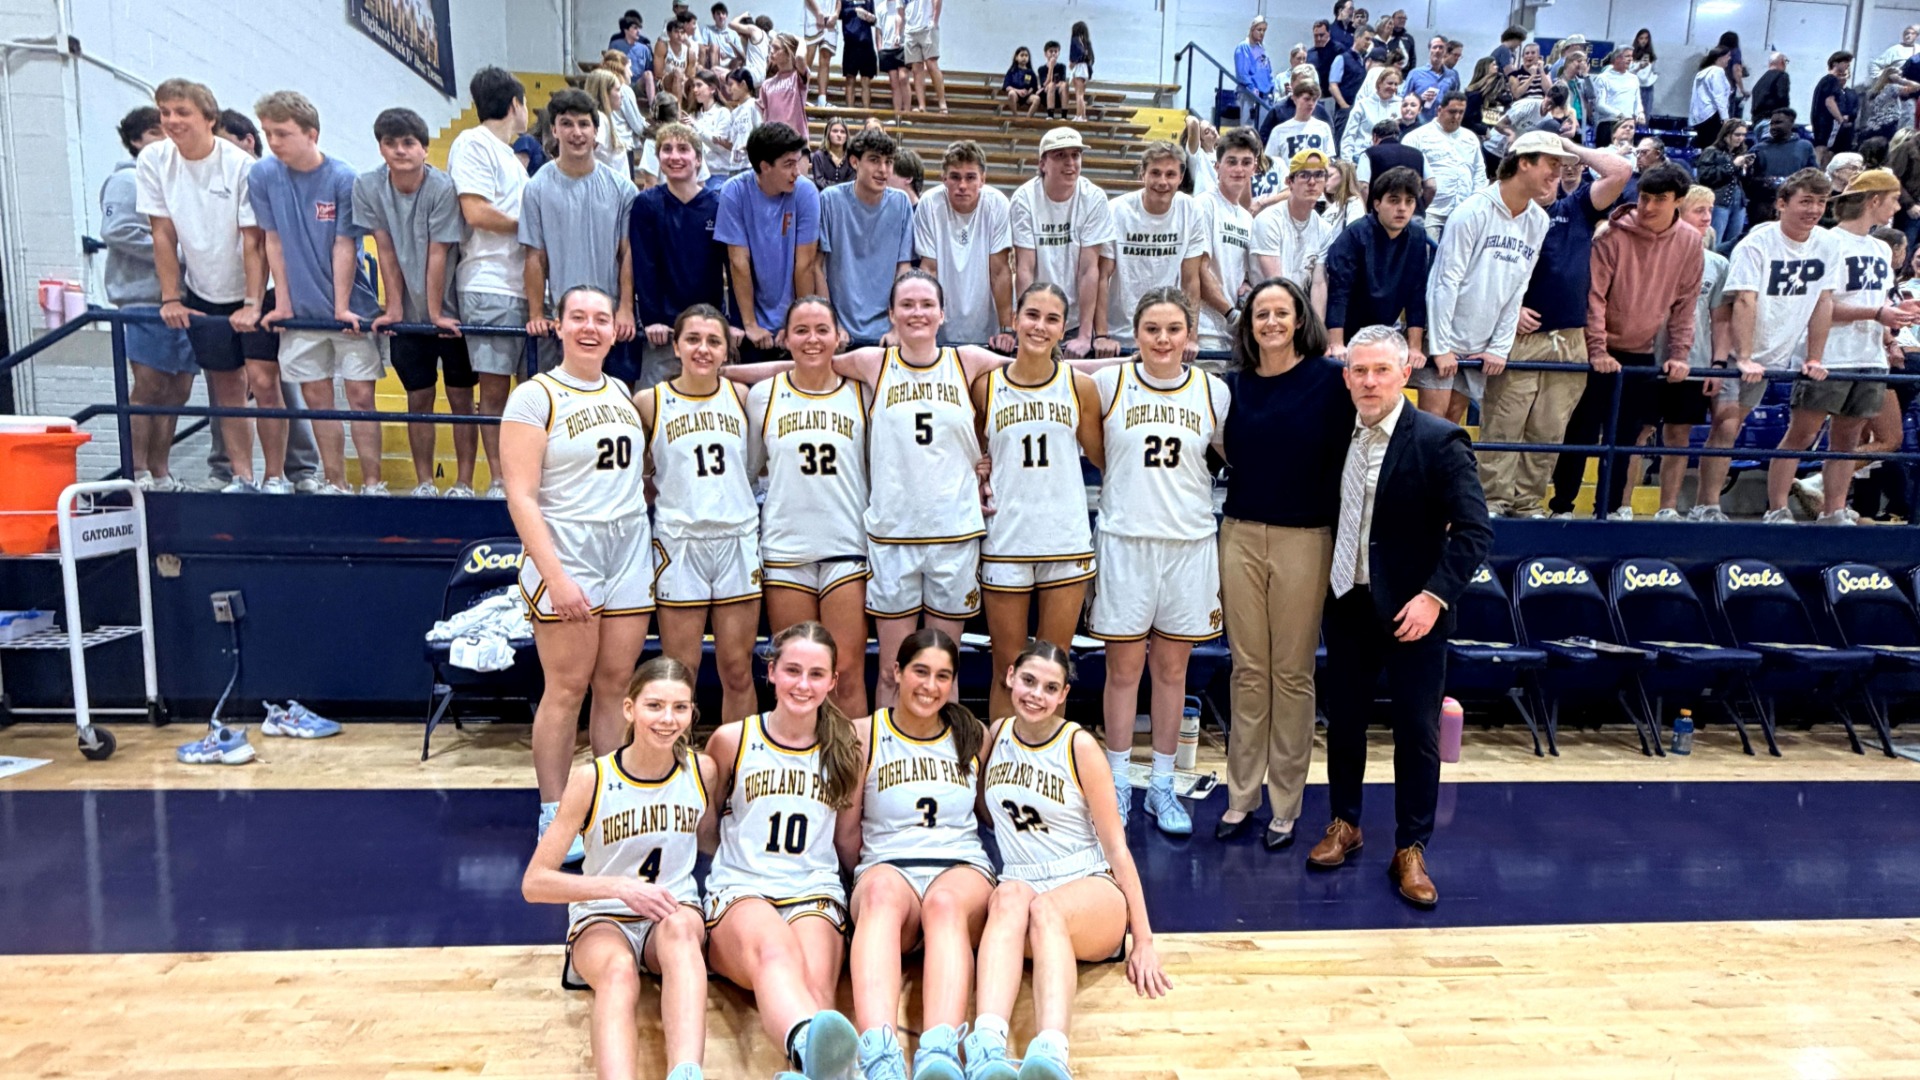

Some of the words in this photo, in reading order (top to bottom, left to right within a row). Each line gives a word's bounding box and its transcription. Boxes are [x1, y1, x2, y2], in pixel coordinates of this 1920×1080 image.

[360, 8, 392, 46] Highland
[390, 33, 407, 59] Park
[1122, 245, 1178, 257] BASKETBALL
[1126, 232, 1150, 243] LADY
[1151, 232, 1178, 243] SCOTS
[1766, 258, 1825, 296] HP
[1845, 256, 1888, 292] HP
[886, 381, 934, 409] HIGHLAND
[937, 382, 962, 408] PARK
[565, 404, 616, 440] HIGHLAND
[665, 411, 716, 445] HIGHLAND
[716, 412, 743, 439] PARK
[777, 410, 827, 440] HIGHLAND
[831, 411, 855, 441] PARK
[914, 412, 934, 446] 5
[994, 401, 1044, 433] HIGHLAND
[1048, 403, 1073, 429] PARK
[1125, 403, 1175, 431] HIGHLAND
[1179, 407, 1202, 437] PARK
[596, 435, 632, 470] 20
[693, 443, 726, 478] 13
[798, 442, 837, 475] 32
[1021, 433, 1050, 468] 11
[1143, 434, 1182, 469] 23
[82, 524, 134, 542] GATORADE
[464, 544, 524, 574] Sco
[1528, 562, 1589, 588] Scots
[1624, 565, 1682, 591] Scots
[1728, 564, 1785, 591] Scots
[1837, 569, 1894, 595] Scots
[744, 768, 806, 804] HIGHLAND
[811, 770, 833, 806] PAR
[878, 757, 938, 793] HIGHLAND
[943, 759, 971, 790] PARK
[985, 762, 1034, 792] HIGHLAND
[1035, 769, 1066, 805] PARK
[602, 803, 668, 846] HIGHLAND
[915, 797, 938, 829] 3
[1001, 799, 1050, 835] 22
[765, 811, 809, 855] 10
[637, 847, 663, 884] 4
